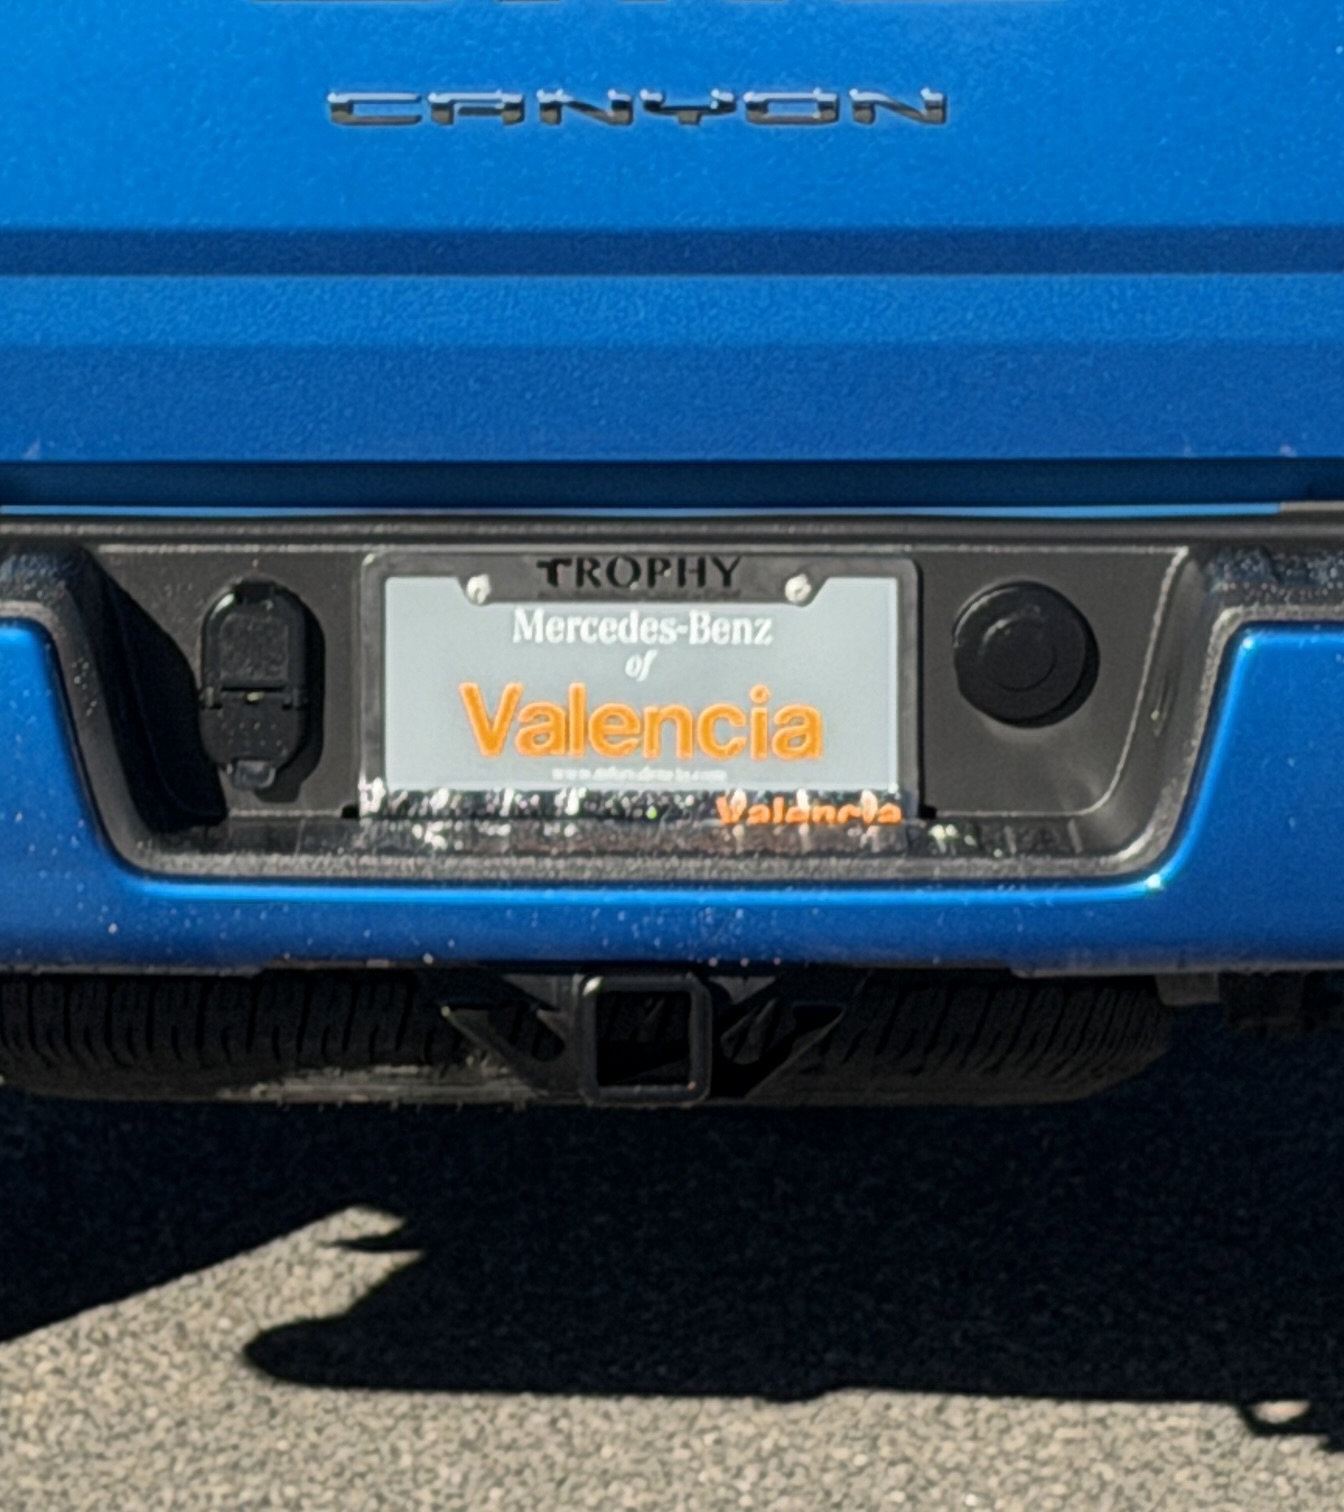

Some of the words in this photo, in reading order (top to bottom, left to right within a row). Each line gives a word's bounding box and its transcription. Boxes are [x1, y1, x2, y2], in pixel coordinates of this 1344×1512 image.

[327, 88, 947, 126] CANYON
[536, 555, 741, 588] TROPHY
[513, 606, 773, 645] Mercedes-Benz
[624, 648, 658, 682] of
[460, 682, 822, 761] Valencia
